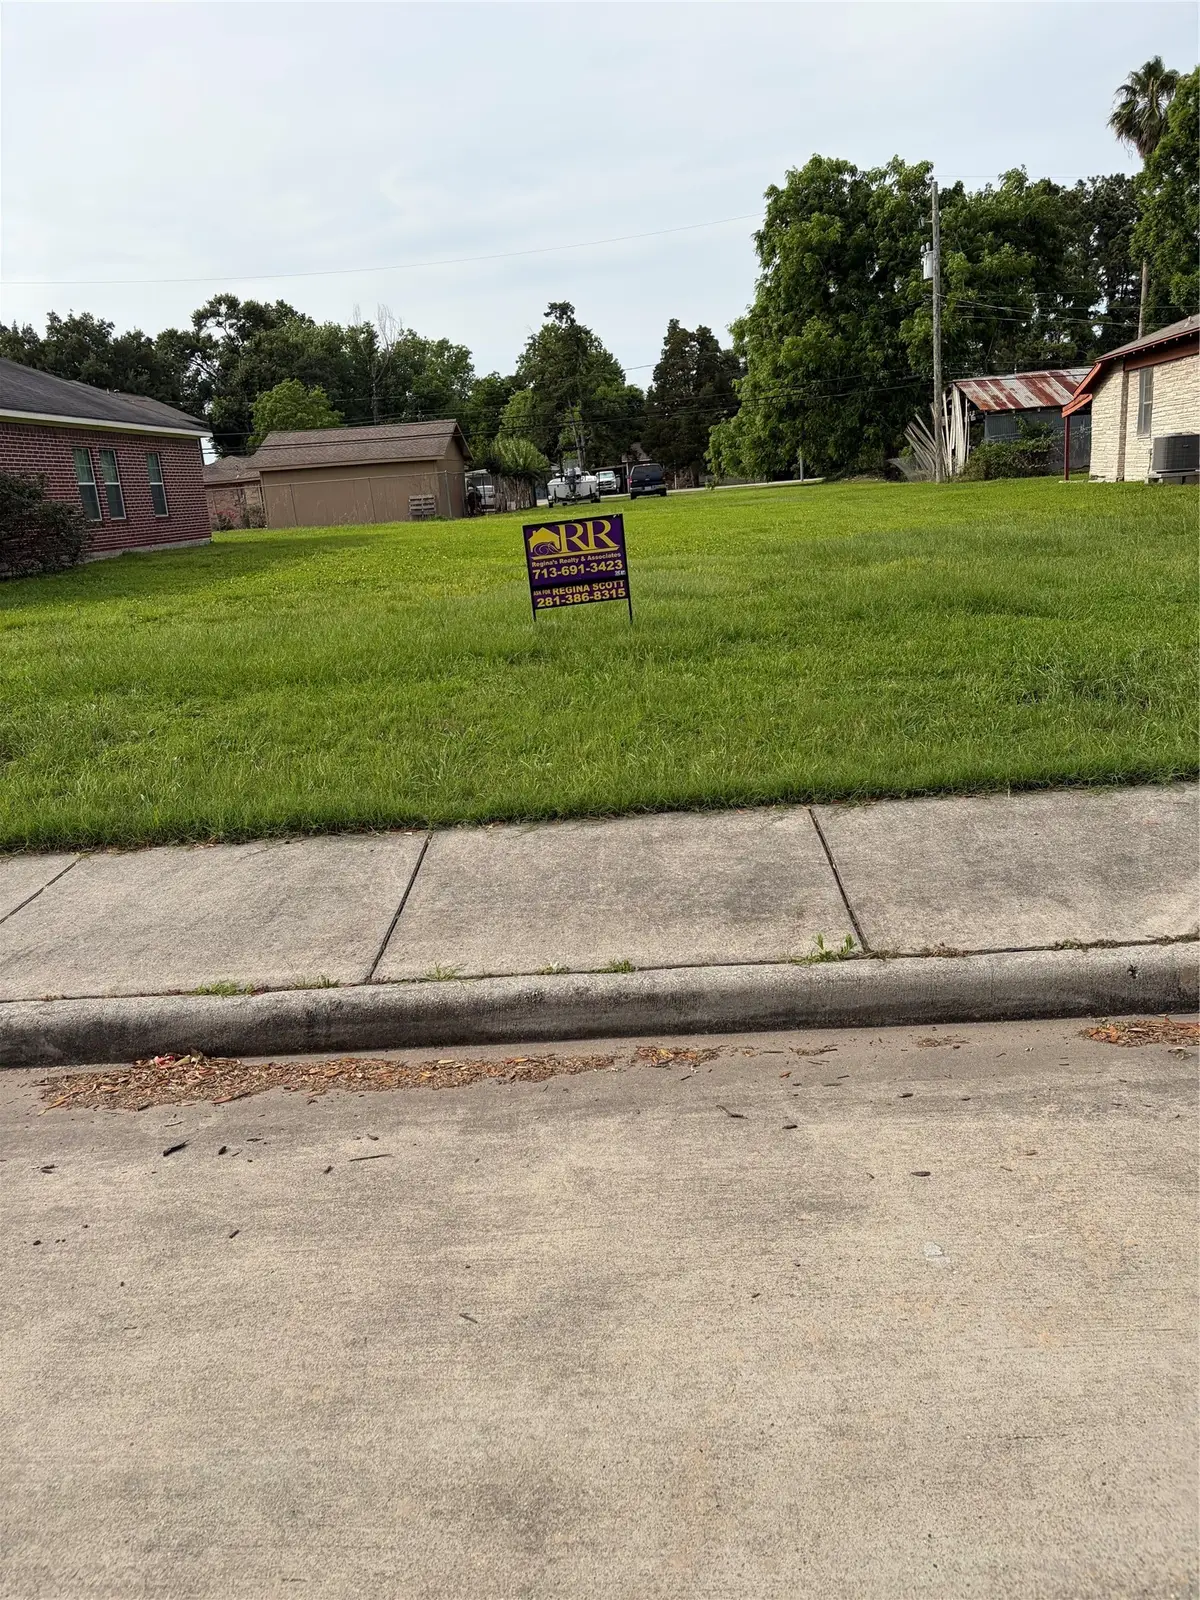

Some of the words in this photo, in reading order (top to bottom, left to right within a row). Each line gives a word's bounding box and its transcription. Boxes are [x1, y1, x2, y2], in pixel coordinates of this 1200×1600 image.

[556, 520, 620, 553] RR
[532, 559, 558, 568] Regina's
[559, 557, 579, 565] Realty
[587, 552, 621, 561] Associates
[533, 560, 623, 580] 713-691-3423
[552, 585, 590, 595] REGINA
[592, 580, 625, 590] SCOTT
[537, 588, 626, 608] 281-386-8315
